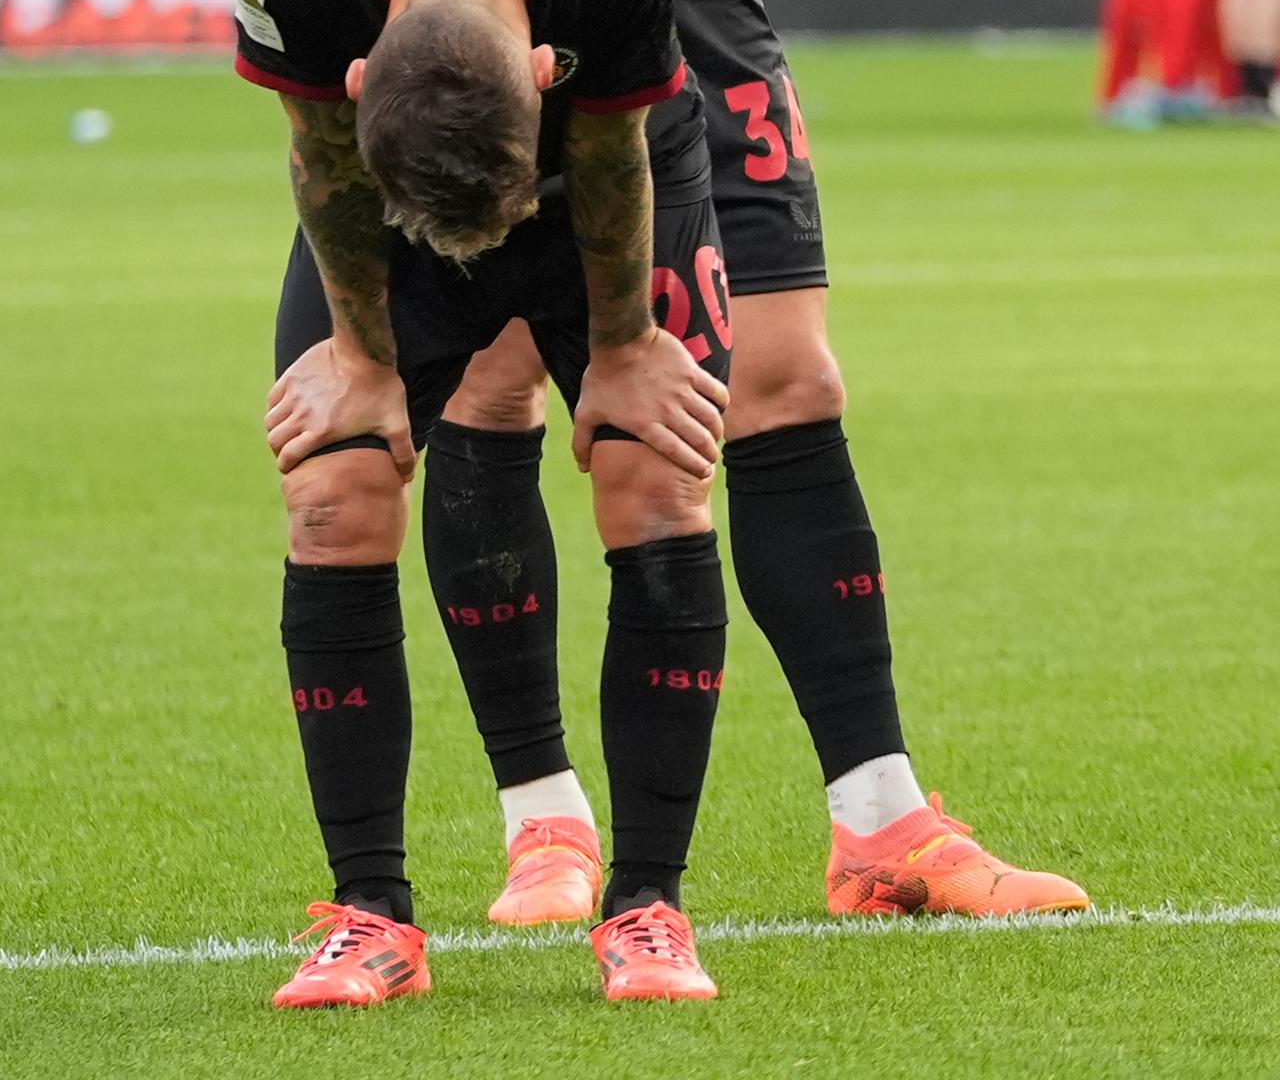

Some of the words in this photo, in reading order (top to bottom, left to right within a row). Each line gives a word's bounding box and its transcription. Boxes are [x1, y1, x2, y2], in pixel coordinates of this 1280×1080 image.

[724, 74, 811, 182] 34
[653, 246, 733, 363] 20
[447, 592, 540, 626] 1904
